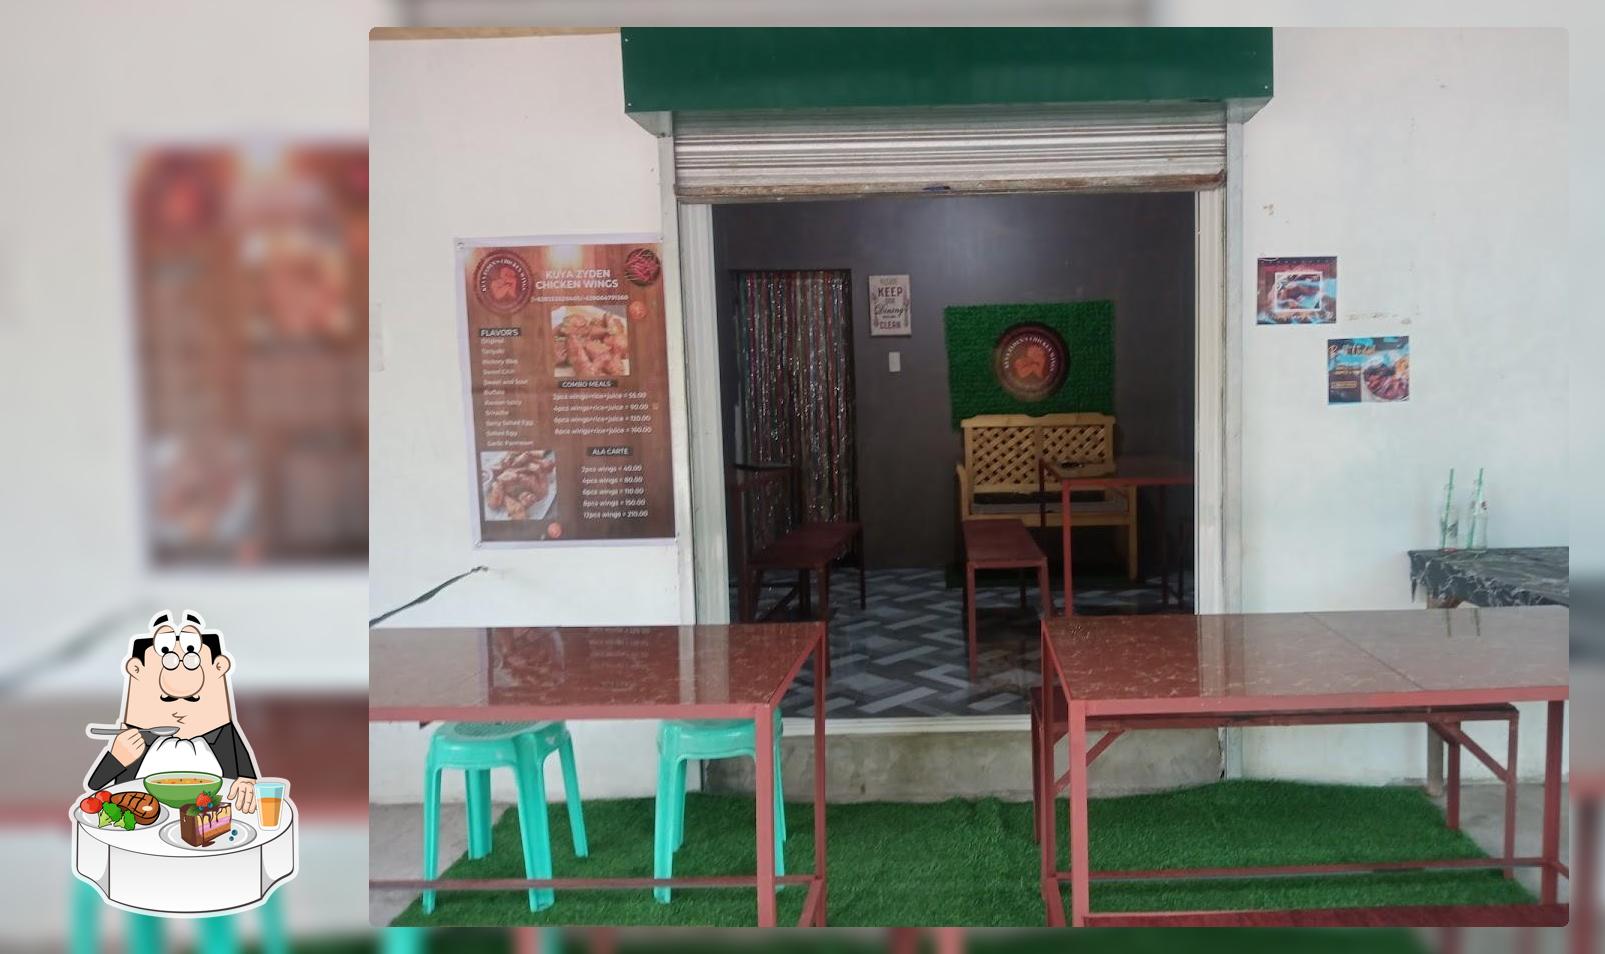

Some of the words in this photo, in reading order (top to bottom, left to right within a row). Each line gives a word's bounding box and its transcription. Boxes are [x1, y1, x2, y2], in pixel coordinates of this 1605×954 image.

[545, 270, 574, 279] KUYA
[576, 269, 611, 278] ZYDEN
[535, 281, 581, 289] CHICKEN
[583, 279, 619, 288] WINGS
[877, 286, 903, 298] KEEP
[607, 447, 630, 455] CARTE
[598, 465, 617, 473] wings
[599, 476, 619, 485] wings
[599, 488, 619, 496] wings
[600, 499, 620, 508] wings
[602, 510, 622, 519] wings
